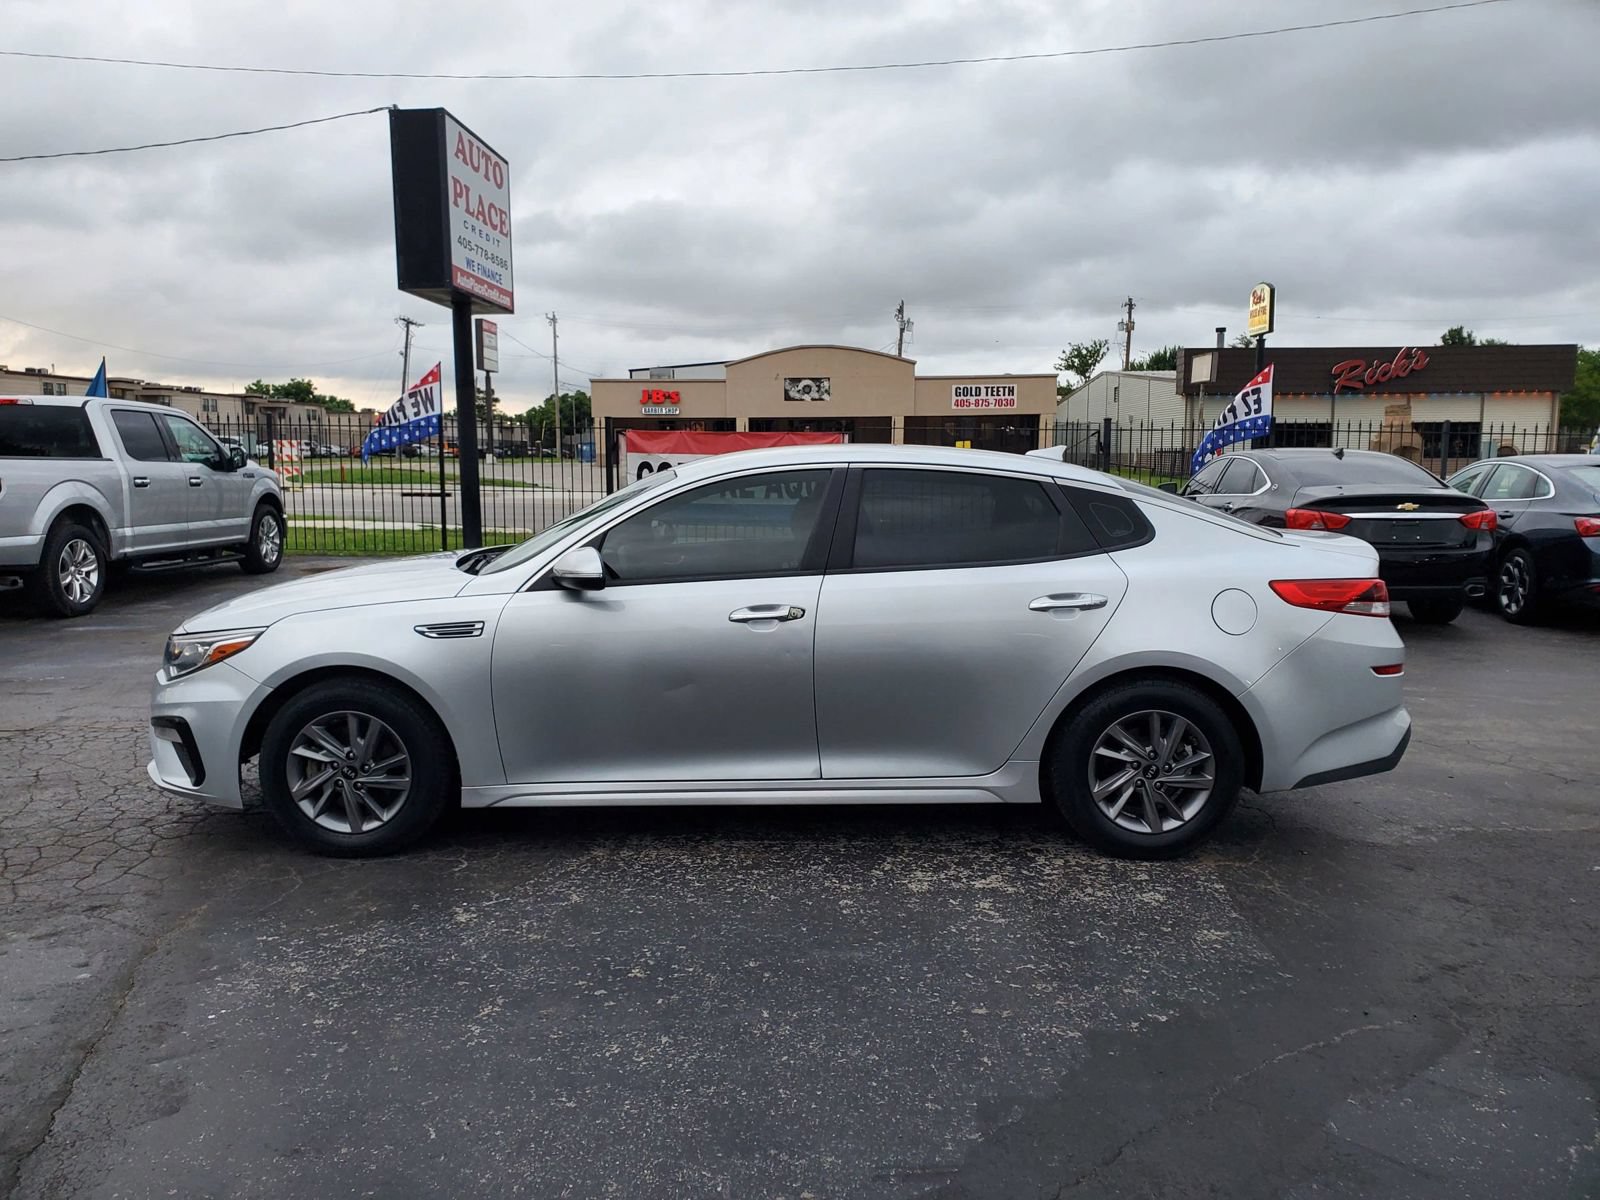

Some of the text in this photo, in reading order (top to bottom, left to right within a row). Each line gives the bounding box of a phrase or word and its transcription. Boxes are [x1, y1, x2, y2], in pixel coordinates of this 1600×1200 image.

[454, 131, 504, 190] AUTO
[451, 176, 509, 239] PLACE
[463, 220, 501, 248] CREDIT
[465, 256, 503, 285] WE FINANCE
[1331, 346, 1430, 395] Rick's
[953, 398, 1015, 408] 405-875-7030
[954, 385, 1015, 397] GOLD TEETH
[342, 766, 355, 779] KIA
[1145, 765, 1156, 778] KIA
